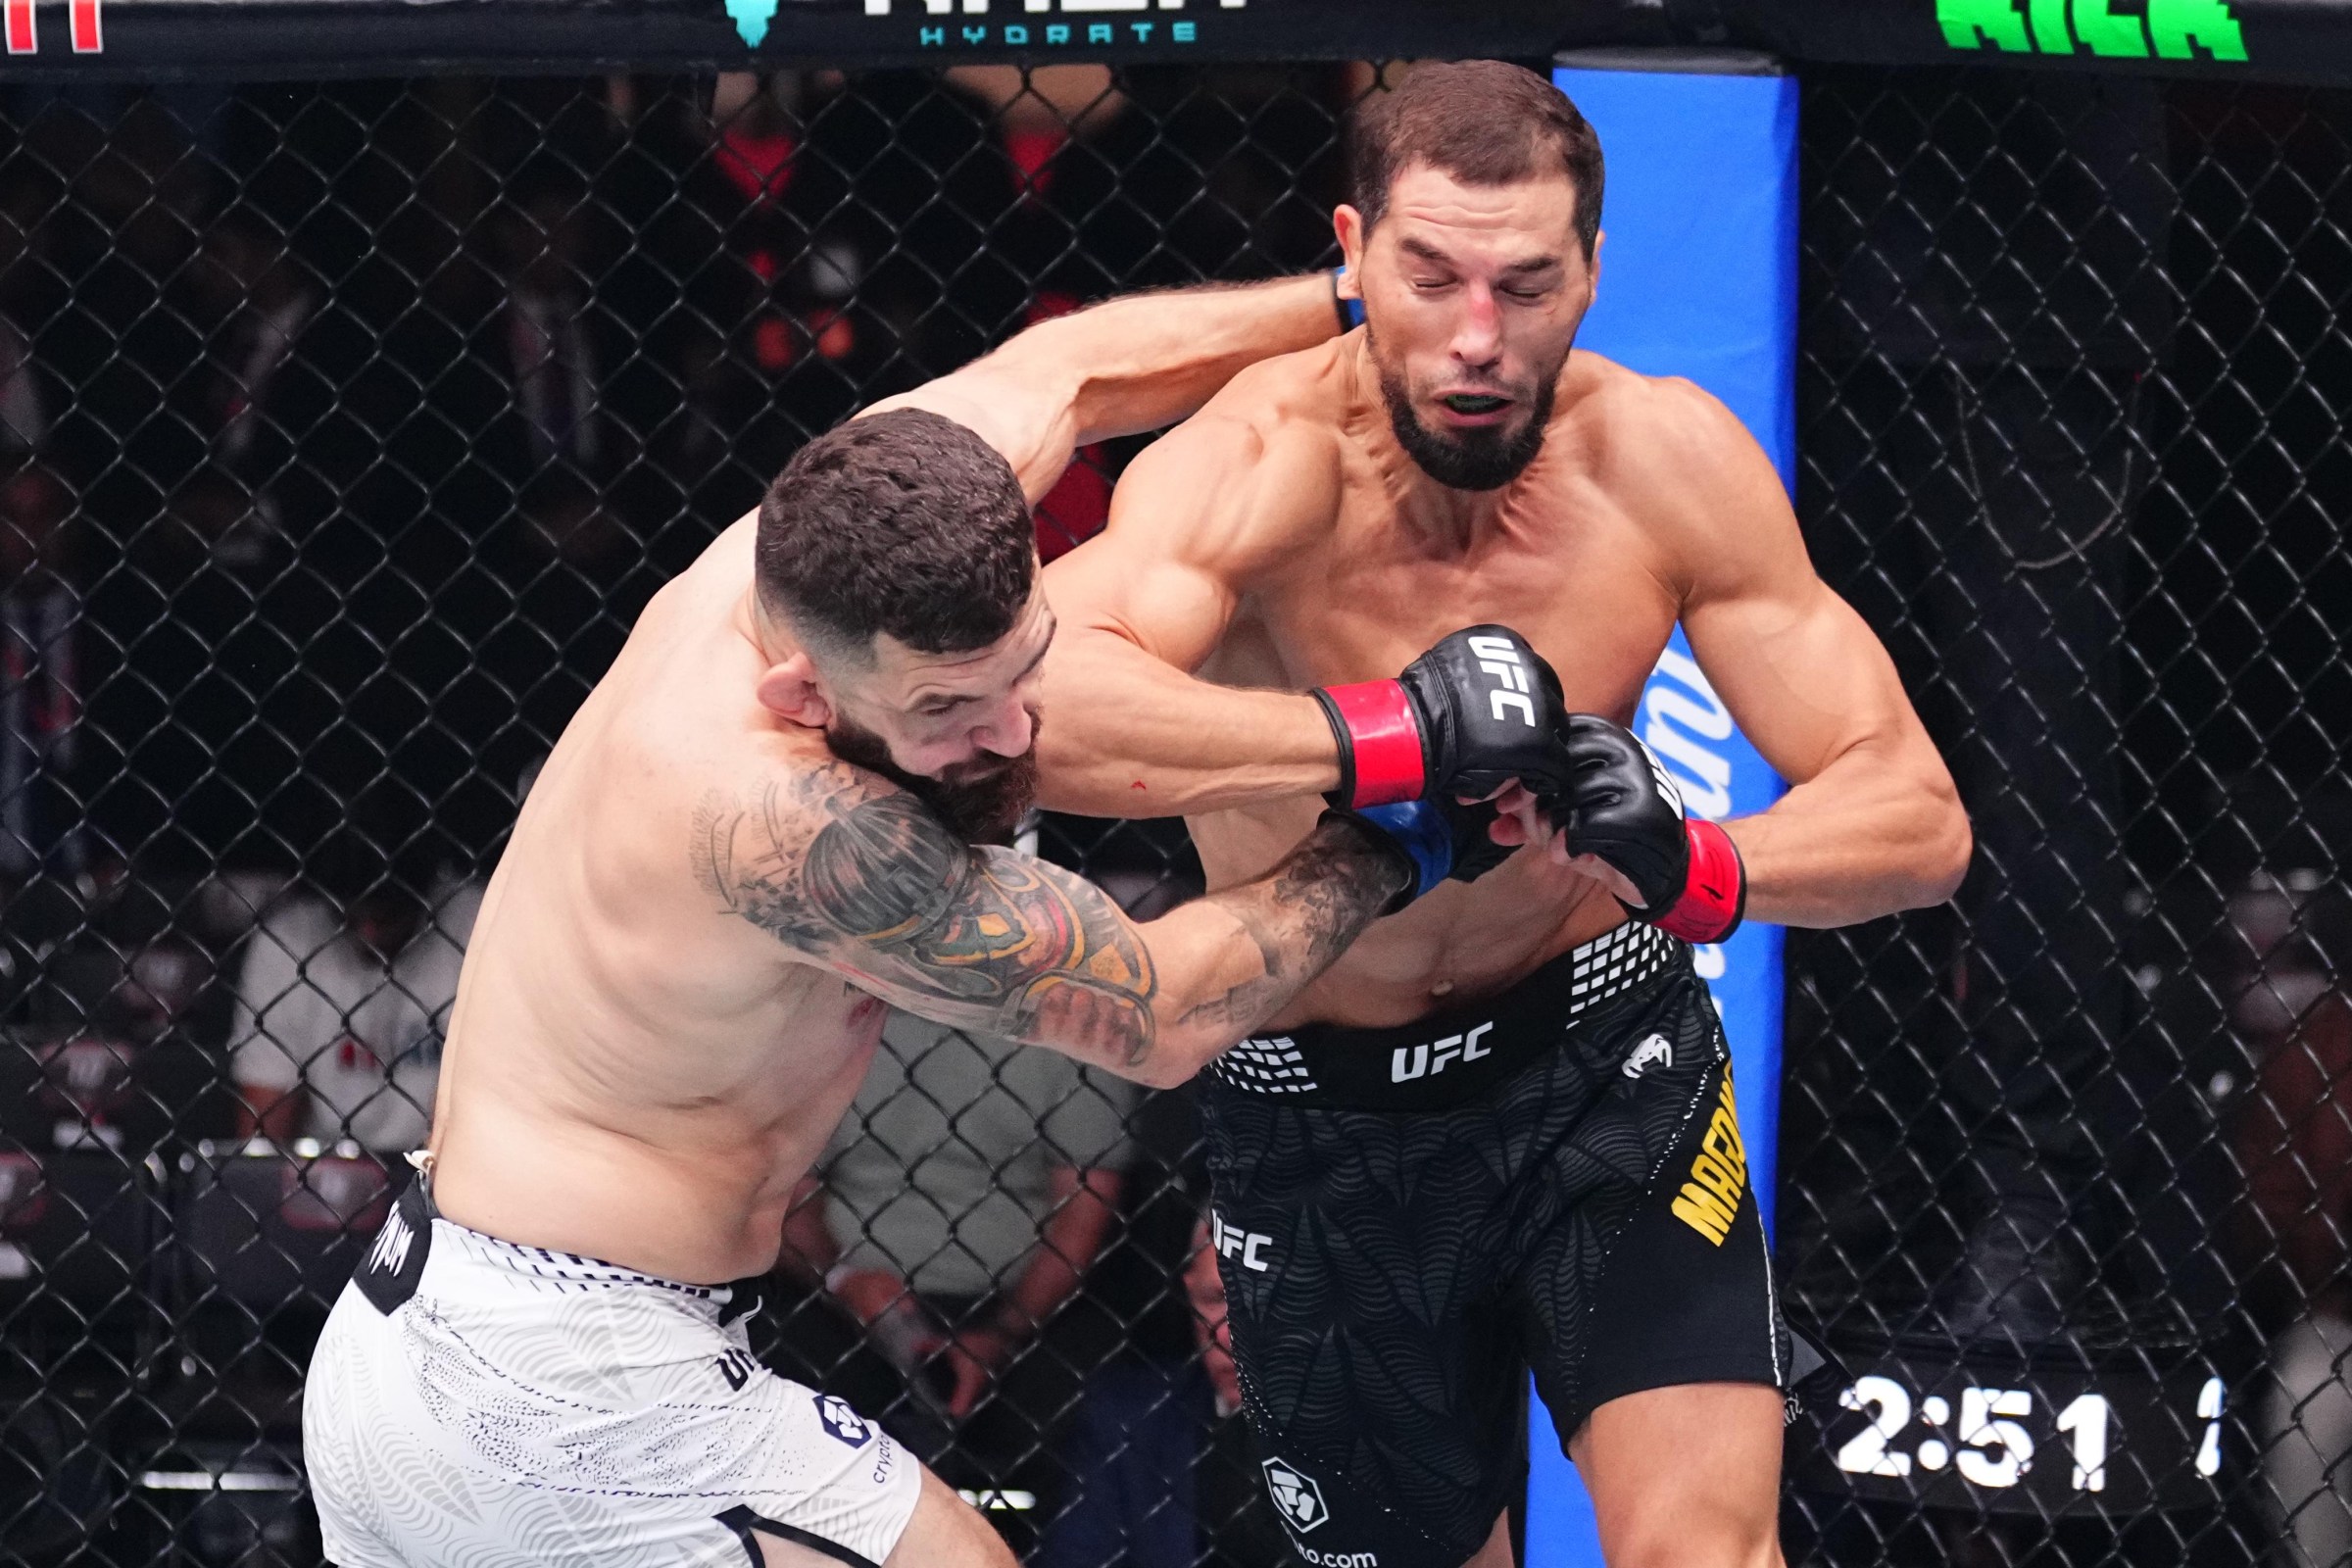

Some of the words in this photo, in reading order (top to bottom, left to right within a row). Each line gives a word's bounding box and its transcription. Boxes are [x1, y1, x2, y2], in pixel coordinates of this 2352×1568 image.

[919, 22, 1198, 46] HYDRATE
[1467, 635, 1536, 728] UFC
[1391, 1020, 1494, 1084] UFC
[1211, 1207, 1273, 1272] UFC
[1837, 1374, 2108, 1493] 2:51
